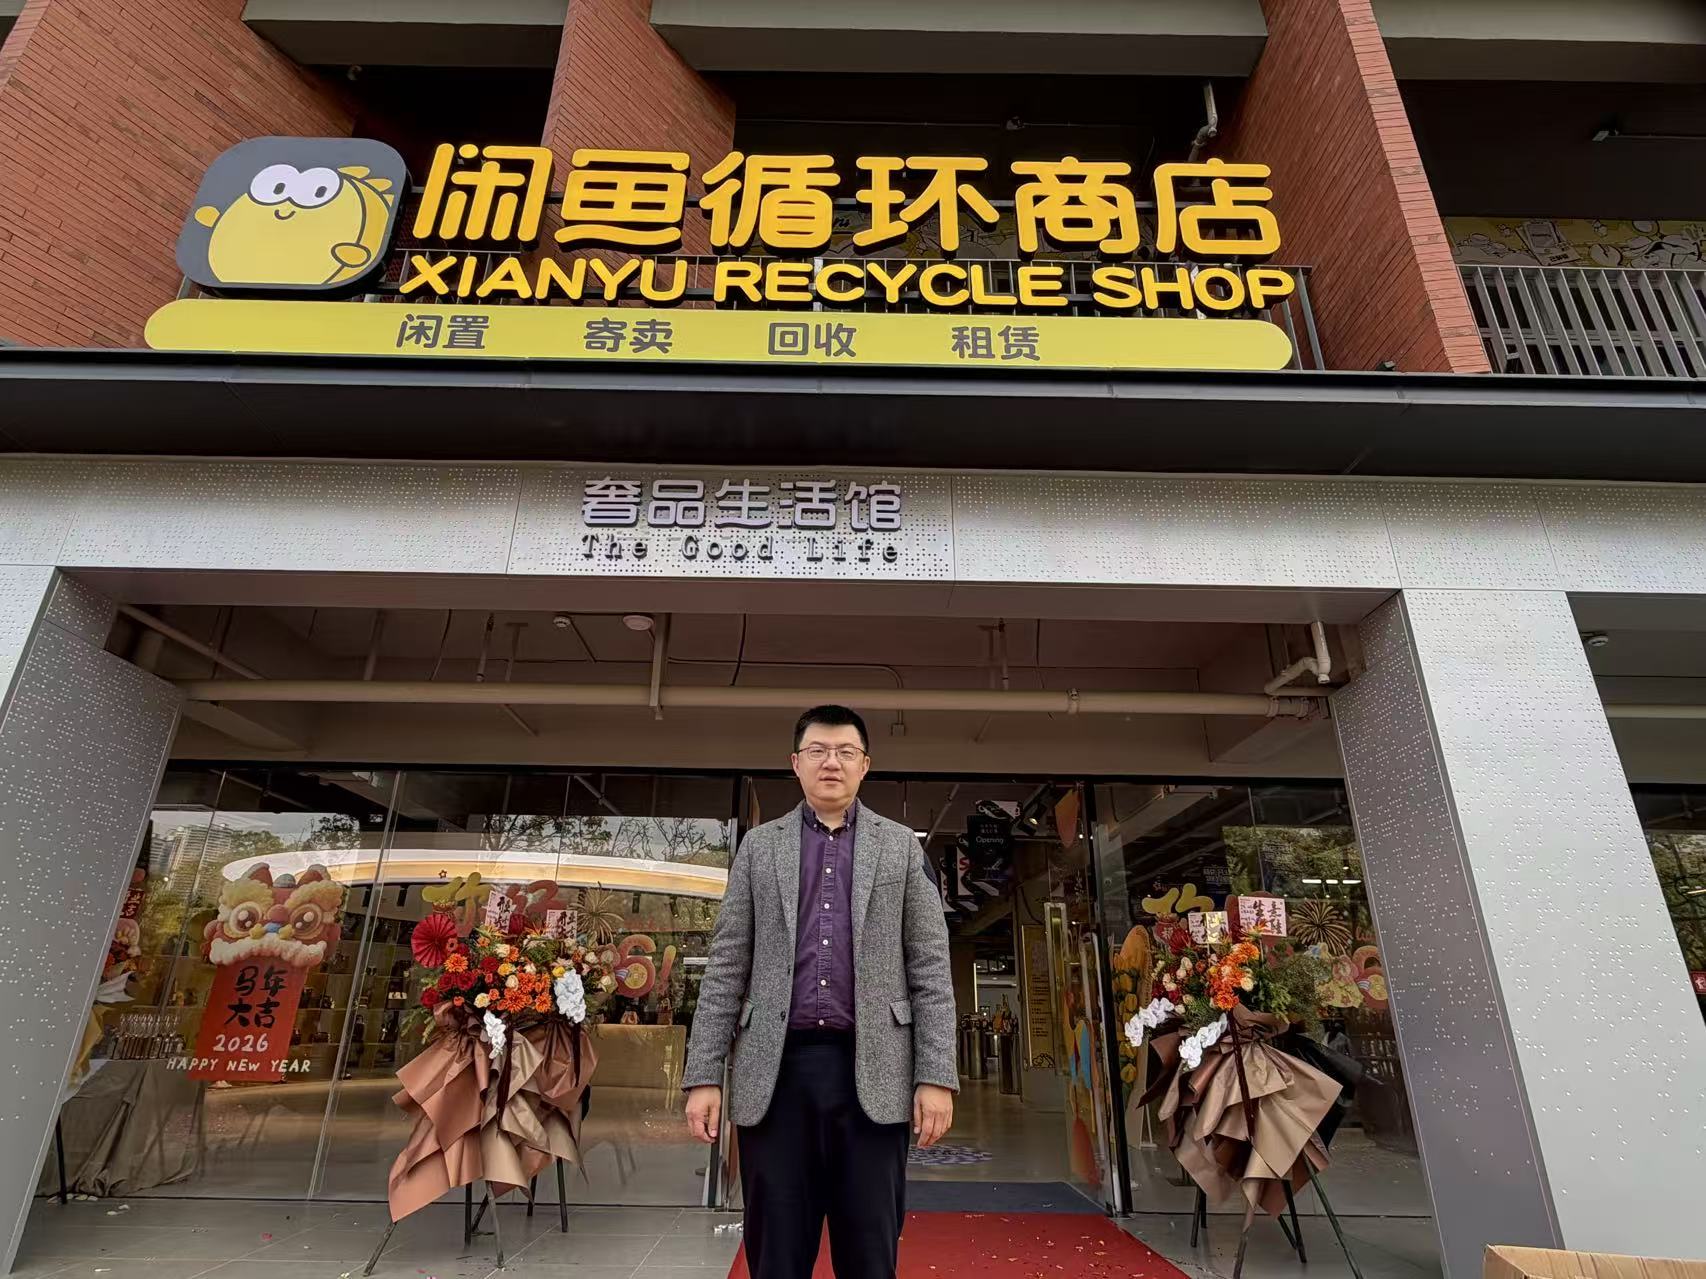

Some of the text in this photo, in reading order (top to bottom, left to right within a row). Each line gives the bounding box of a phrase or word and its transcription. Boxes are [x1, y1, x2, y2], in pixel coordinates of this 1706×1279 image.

[412, 143, 1281, 254] 闲鱼循环商店
[399, 255, 1295, 311] XIANYU RECYCLE SHOP
[396, 314, 1041, 361] 闲置 寄卖 回收 租赁
[582, 476, 900, 532] 奢品生活馆
[582, 534, 899, 563] The Good Life
[223, 1000, 280, 1030] 大吉
[212, 1033, 269, 1053] 2026
[166, 1057, 218, 1072] HAPPY
[271, 1059, 311, 1074] YEAR
